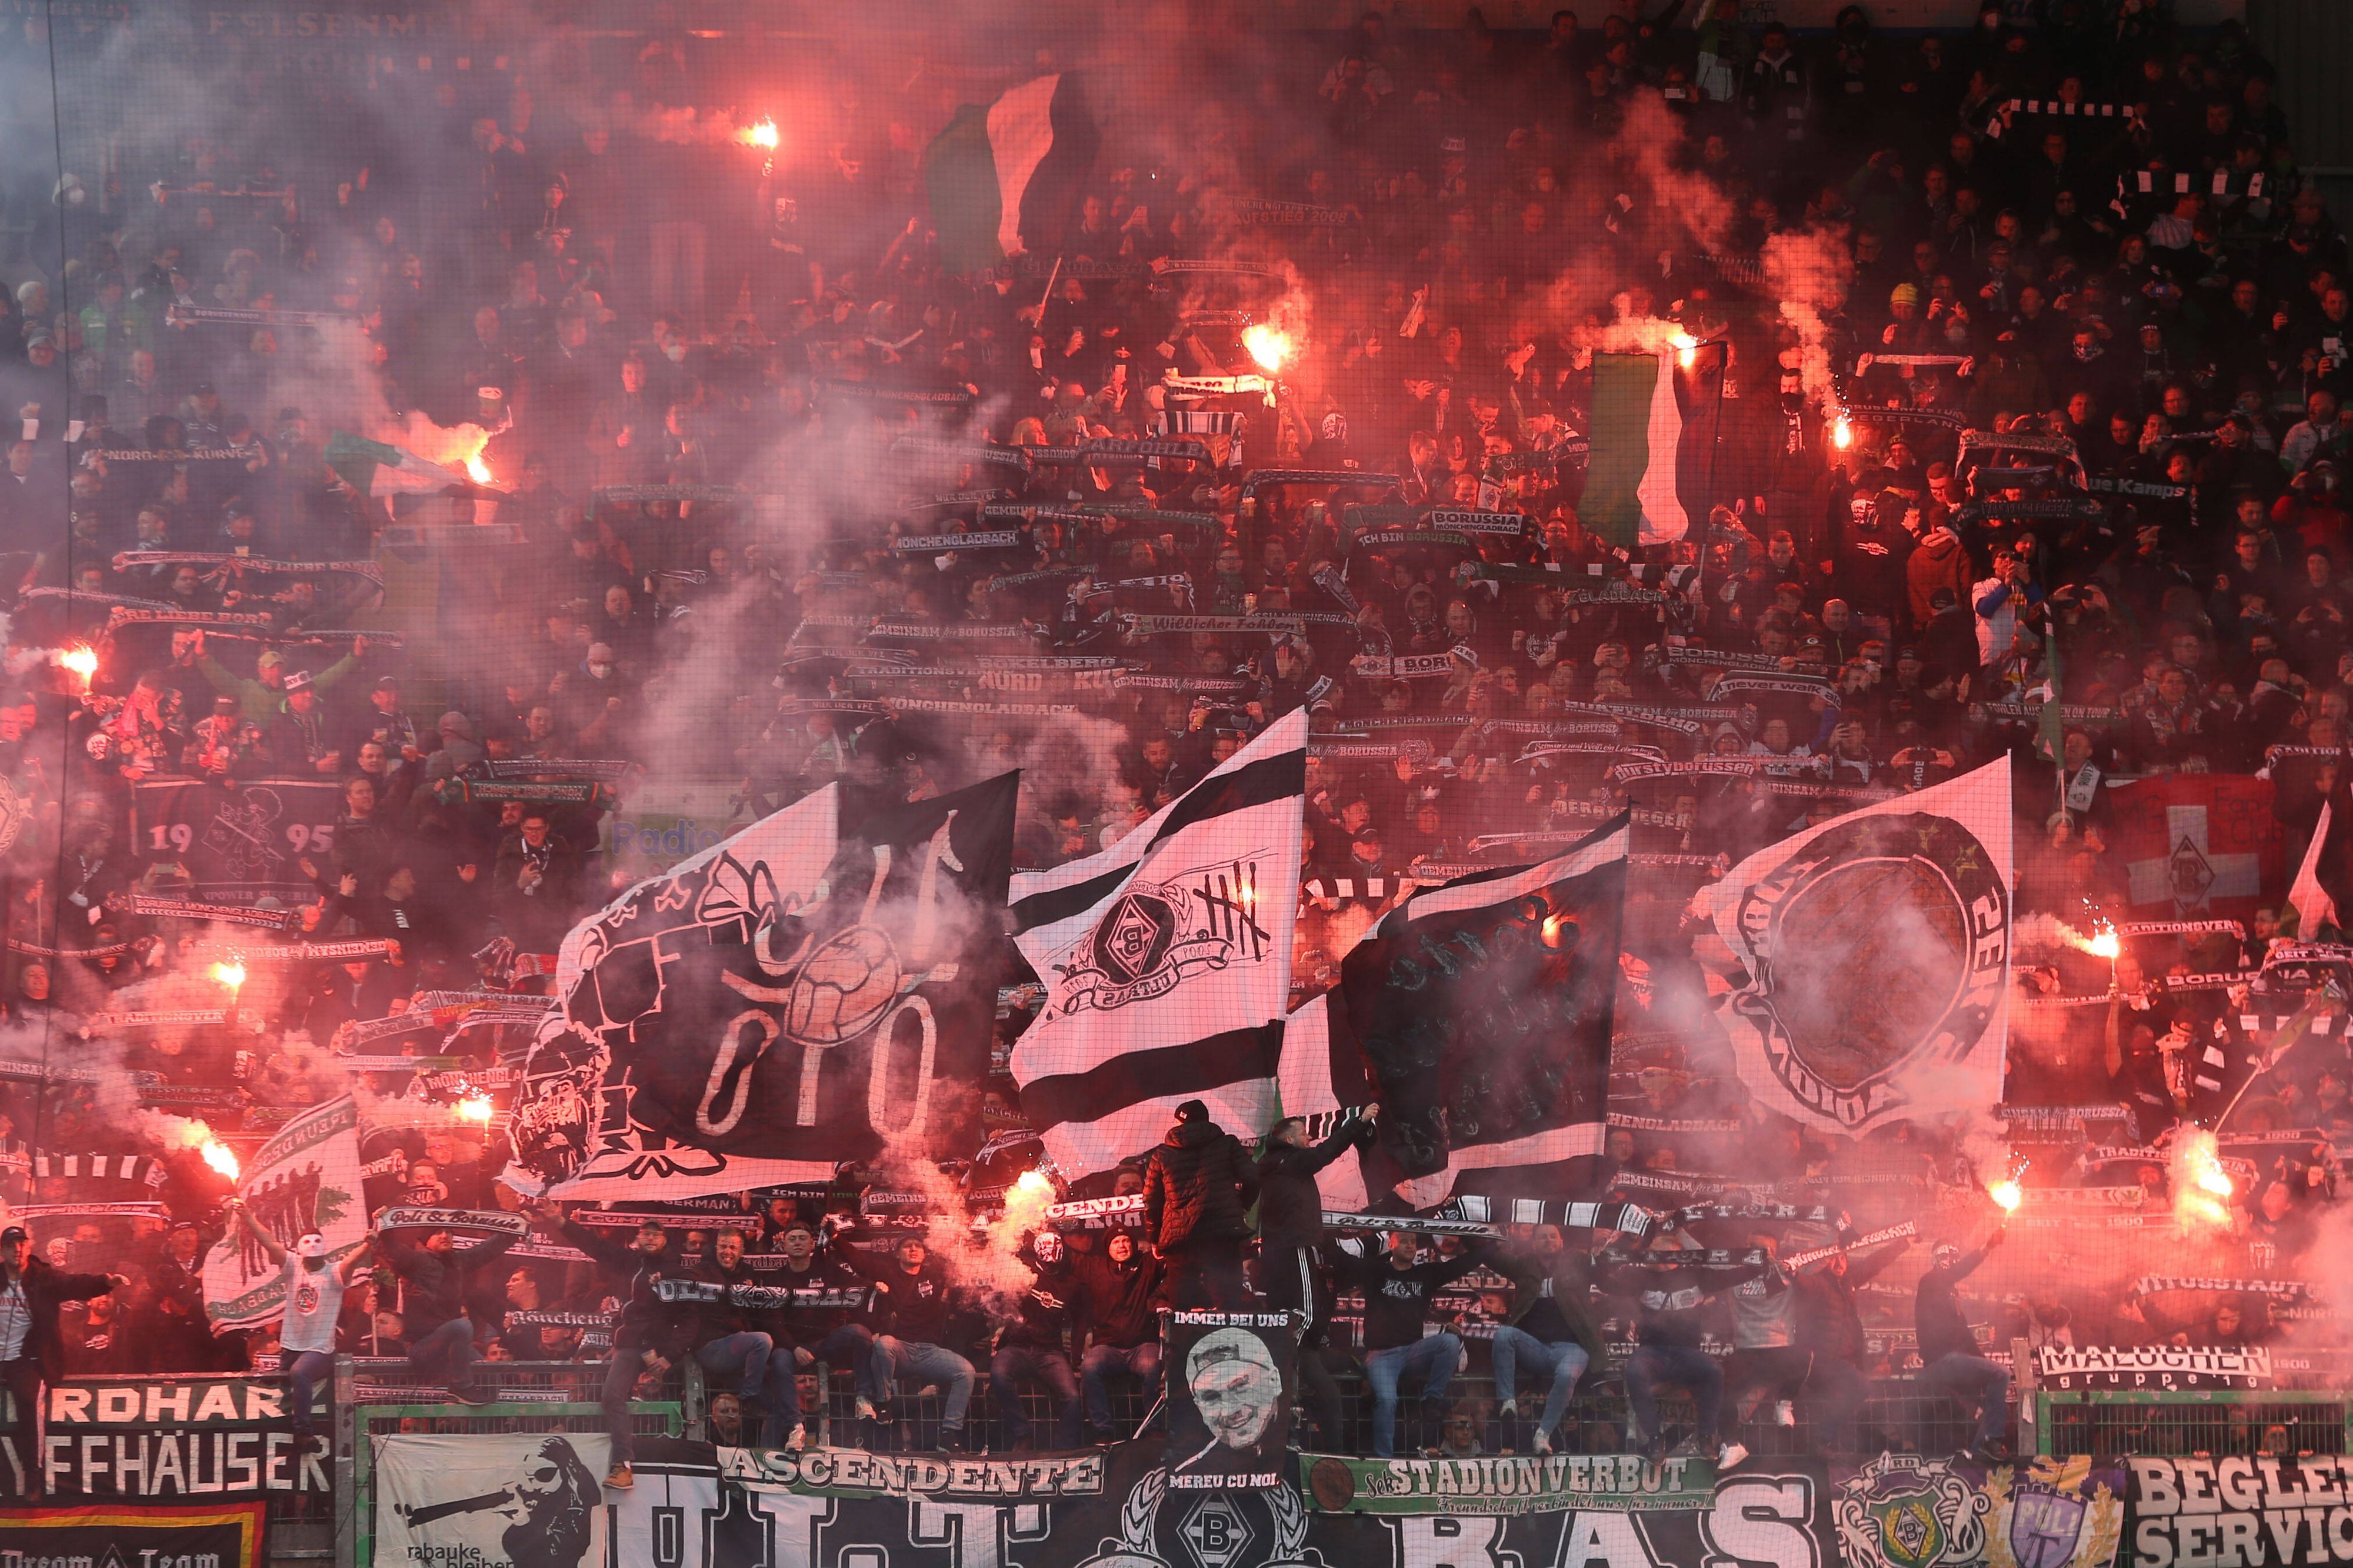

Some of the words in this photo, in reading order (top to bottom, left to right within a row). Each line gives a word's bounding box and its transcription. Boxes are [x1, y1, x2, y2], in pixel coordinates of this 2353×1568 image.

[2118, 479, 2186, 498] Kamps
[1435, 513, 1518, 525] BORUSSIA
[1435, 523, 1519, 533] MÖNCHENGLADBACH
[1381, 533, 1404, 543] BIN
[156, 609, 213, 622] LIEBE
[1727, 680, 1775, 691] never
[1779, 682, 1821, 695] walk
[1339, 745, 1398, 757] BORUSSIA
[148, 823, 193, 853] 19
[285, 824, 335, 853] 95
[136, 899, 183, 910] BORUSSIA
[185, 902, 284, 922] MÖNCHENGLADBACH
[390, 1209, 421, 1224] Poli
[428, 1210, 445, 1222] &
[447, 1210, 521, 1230] Borussia
[656, 1279, 725, 1302] ULT
[791, 1286, 867, 1307] RAS
[1174, 1312, 1226, 1326] IMMER
[1229, 1312, 1254, 1326] BEI
[1257, 1312, 1288, 1327] UNS
[719, 1450, 1106, 1496] ASCENDENTE
[1169, 1473, 1225, 1489] MEREU
[1226, 1473, 1247, 1487] CU
[1249, 1471, 1280, 1487] NOI.
[1387, 1457, 1688, 1496] STADIONVERBOT
[2134, 1456, 2353, 1516] BEGLE
[1201, 1510, 1234, 1554] B
[407, 1542, 481, 1561] rabauke
